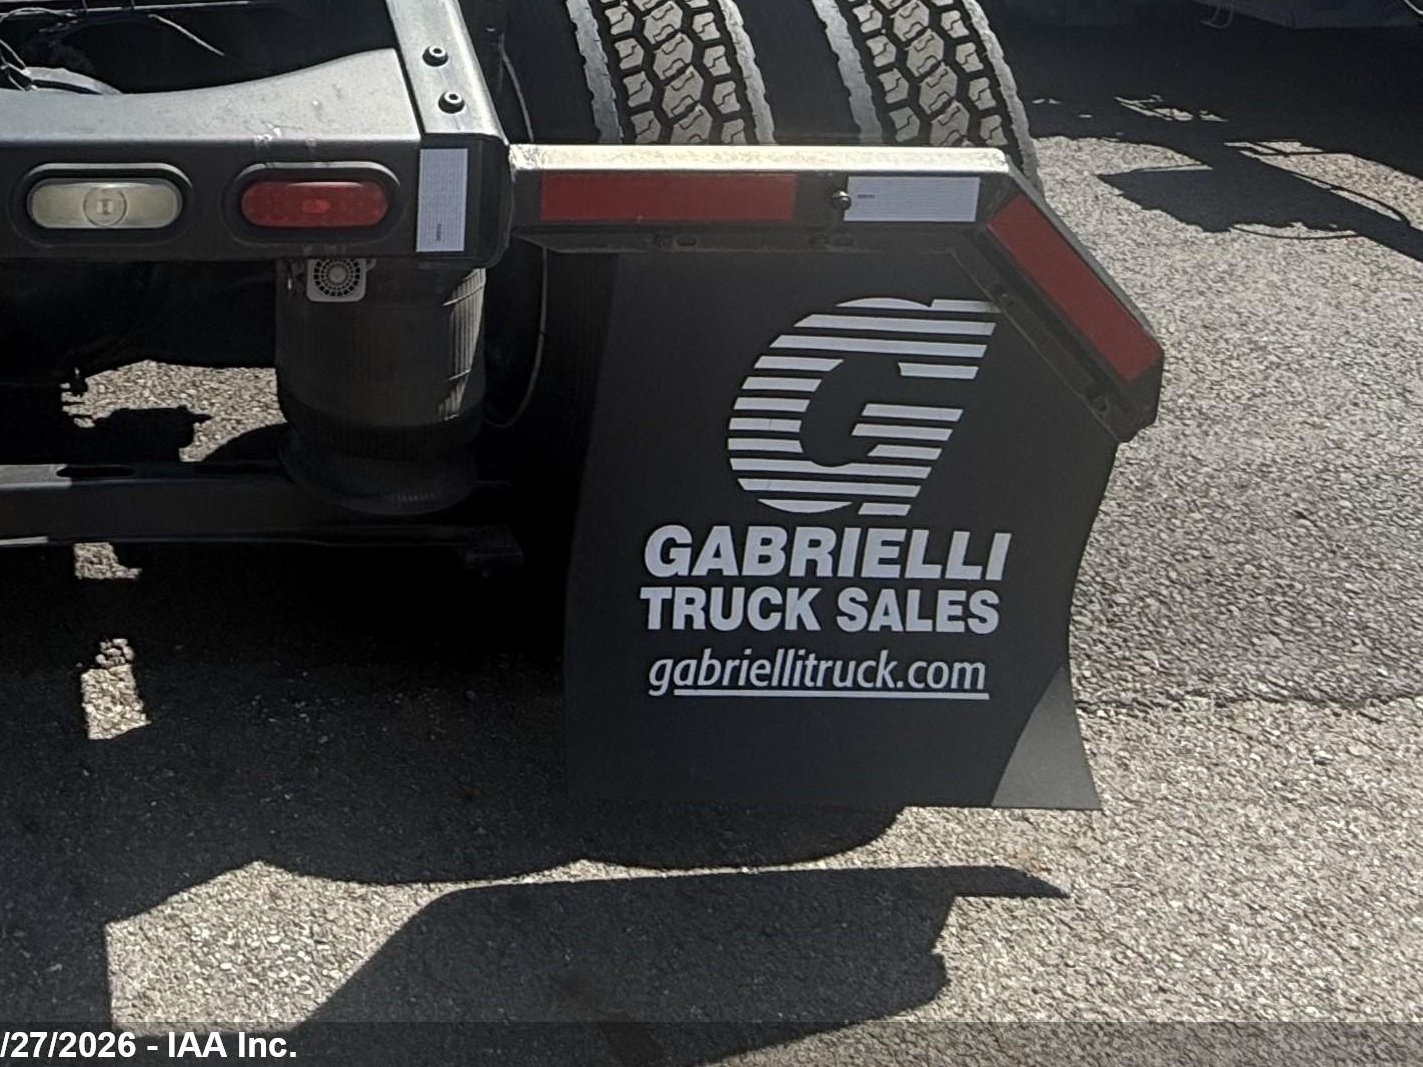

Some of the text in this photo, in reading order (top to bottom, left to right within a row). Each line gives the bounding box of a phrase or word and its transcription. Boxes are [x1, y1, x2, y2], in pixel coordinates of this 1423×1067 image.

[728, 297, 1001, 516] G
[644, 524, 1012, 582] GABRIELLI
[640, 586, 1000, 634] TRUCK SALES
[648, 648, 990, 699] gabriellitruck.com
